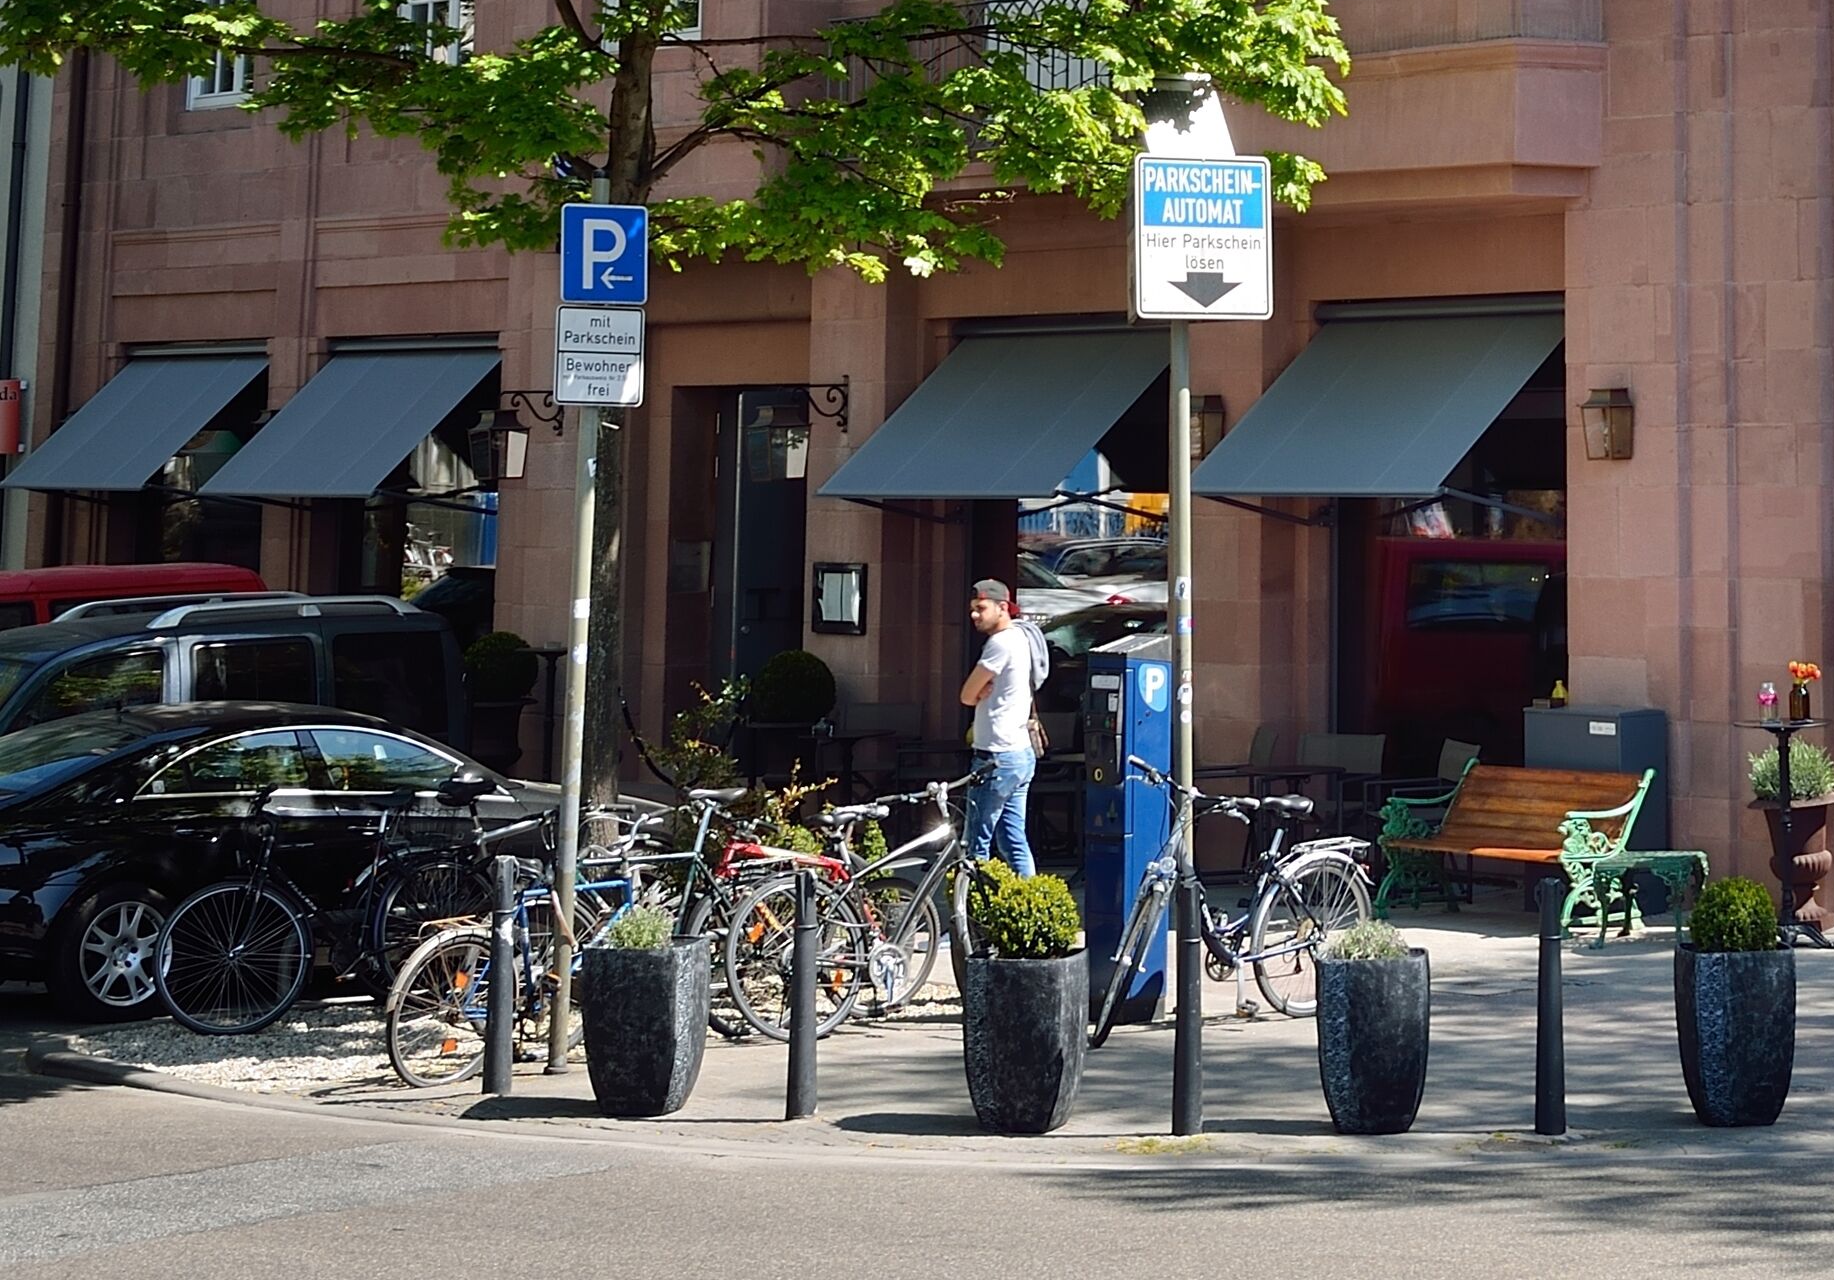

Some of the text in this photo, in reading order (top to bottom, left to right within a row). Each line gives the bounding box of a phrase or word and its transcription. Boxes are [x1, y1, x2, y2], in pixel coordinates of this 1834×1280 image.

[1145, 165, 1262, 195] PARKSCHEIN-
[1162, 197, 1244, 225] AUTOMAT
[1146, 233, 1262, 251] Hier Parkschein
[582, 218, 627, 289] P
[1185, 255, 1225, 270] lösen
[590, 315, 611, 328] mit
[564, 330, 636, 346] Parkschein
[566, 357, 633, 373] Bewohner
[587, 383, 610, 397] frei
